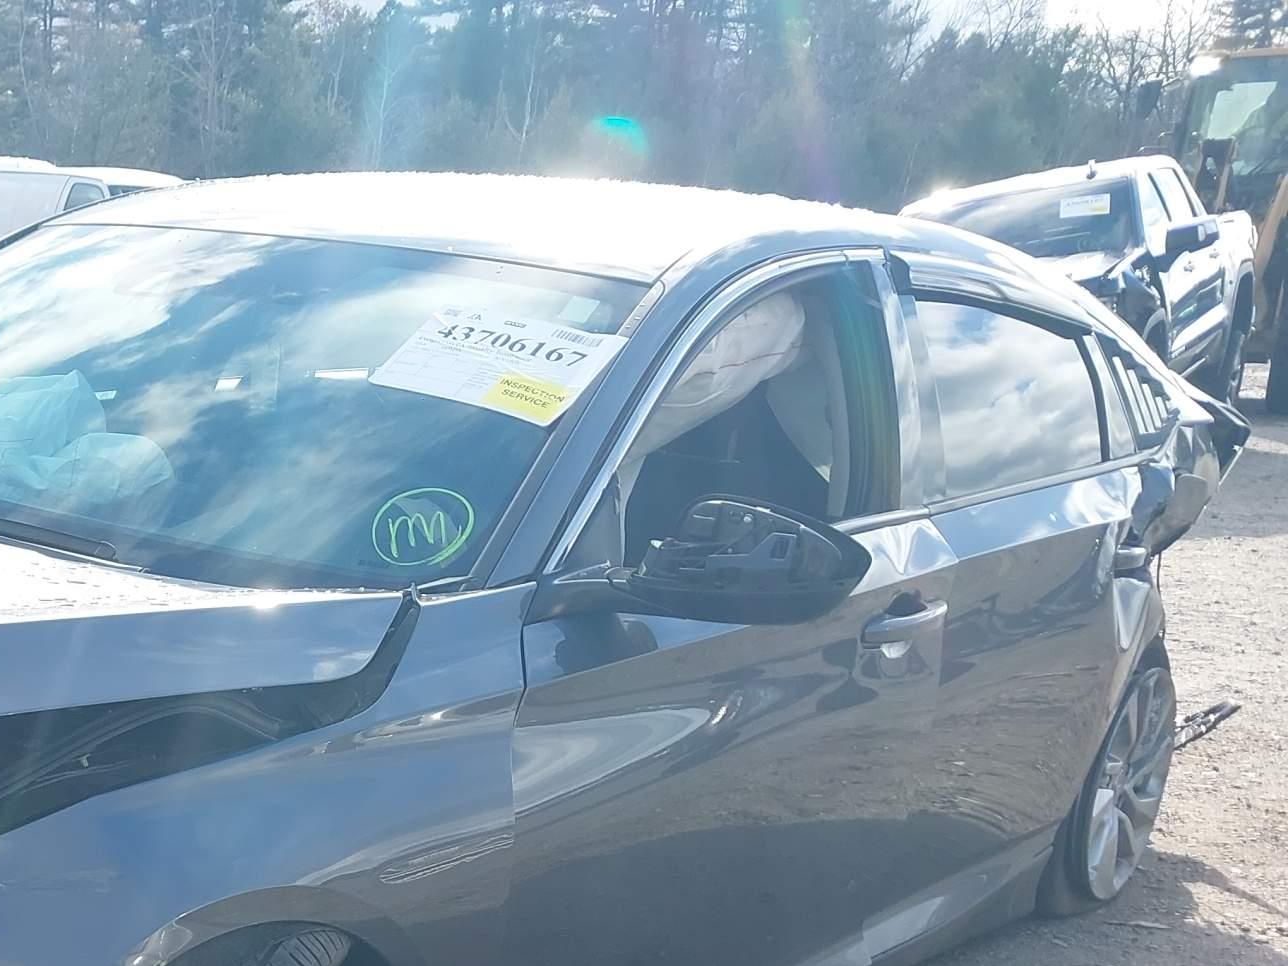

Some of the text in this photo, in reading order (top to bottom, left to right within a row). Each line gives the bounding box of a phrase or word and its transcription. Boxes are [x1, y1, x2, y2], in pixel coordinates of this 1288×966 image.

[437, 324, 588, 367] 43706167
[499, 378, 566, 403] INSPECTION
[501, 388, 551, 409] SERVICE
